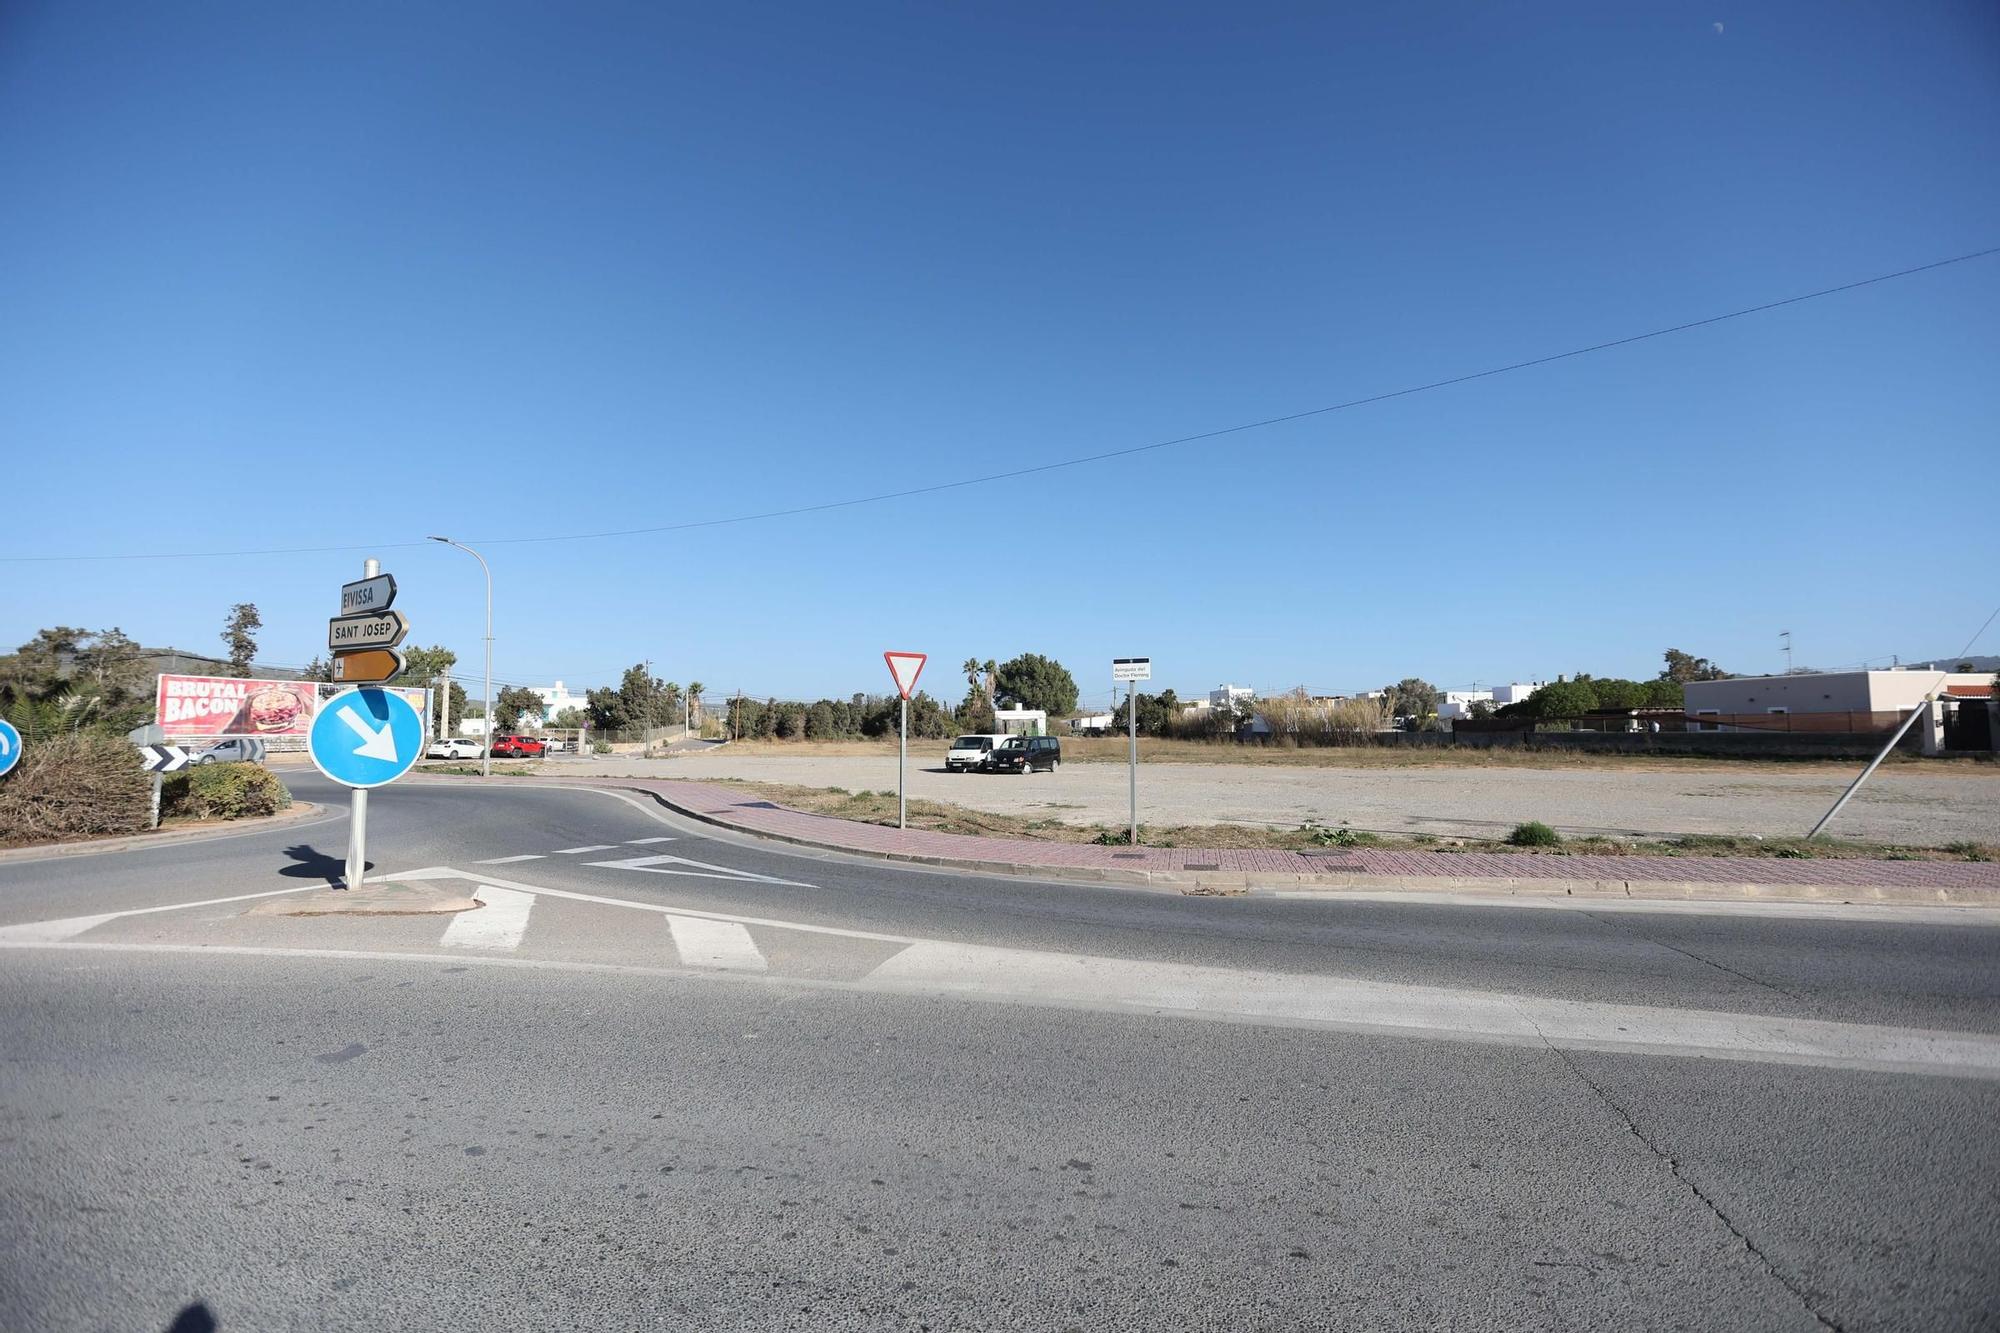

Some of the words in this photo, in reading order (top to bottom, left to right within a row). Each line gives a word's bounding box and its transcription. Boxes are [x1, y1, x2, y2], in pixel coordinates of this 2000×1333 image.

[343, 587, 374, 608] EIVISSA
[335, 625, 358, 639] SANT
[363, 622, 391, 637] JOSEP
[167, 680, 247, 699] BRUTAL
[164, 697, 238, 723] BACON
